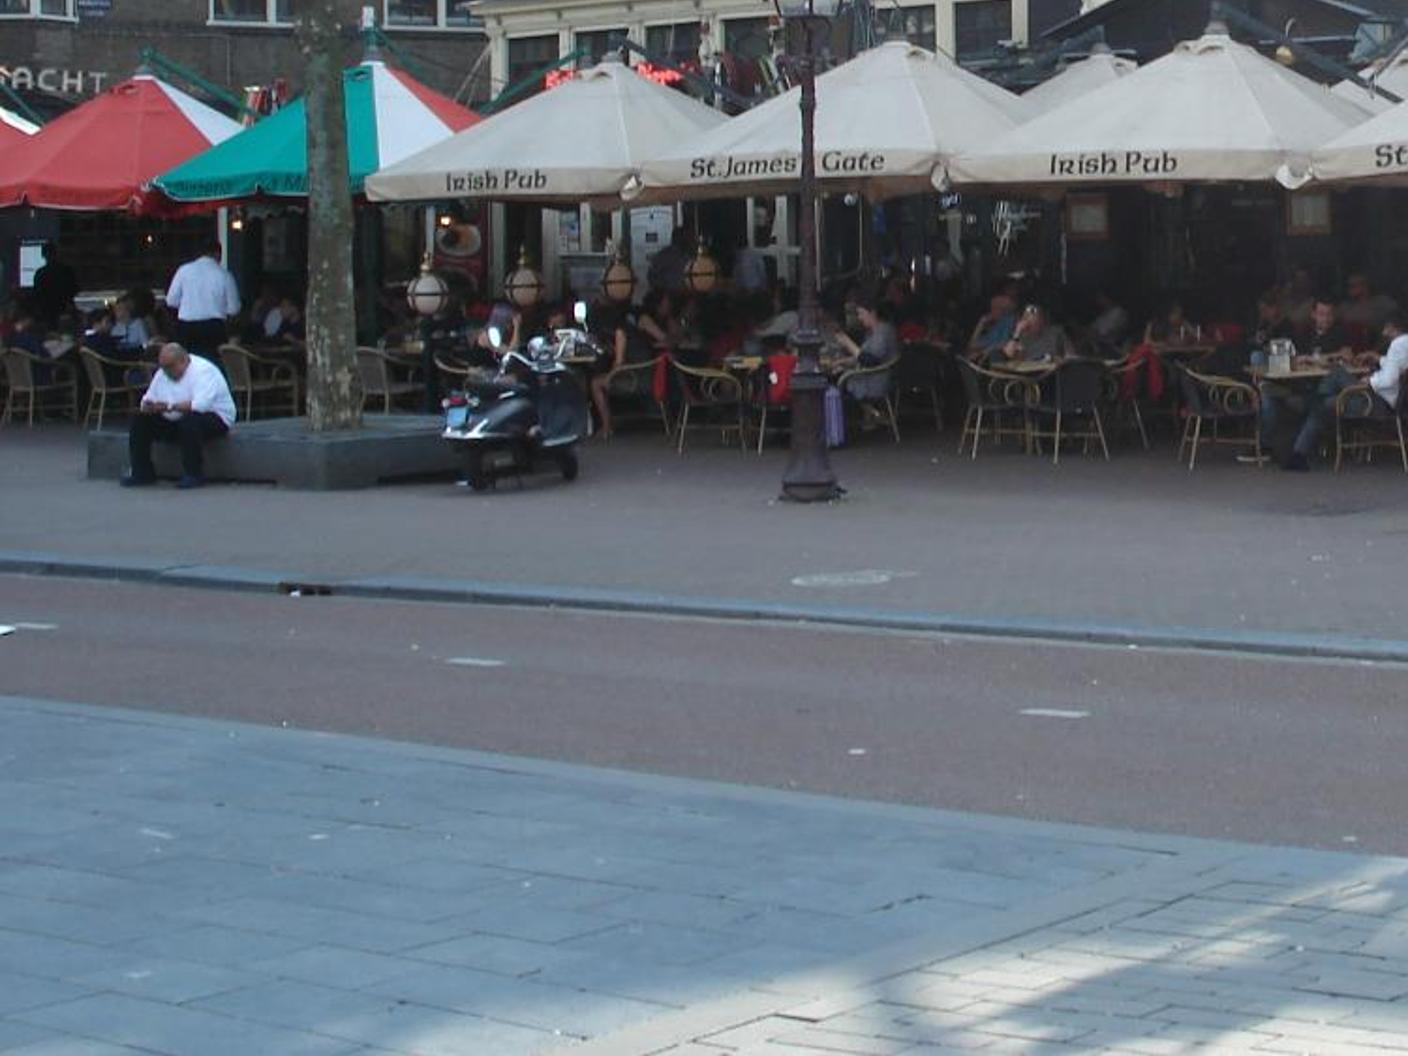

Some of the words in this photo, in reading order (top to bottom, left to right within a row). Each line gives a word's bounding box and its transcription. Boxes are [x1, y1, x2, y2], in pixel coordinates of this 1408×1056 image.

[11, 66, 107, 94] ACHT
[821, 150, 885, 172] Gate
[1050, 151, 1117, 175] Irish
[1125, 150, 1178, 173] Pub
[446, 169, 499, 192] Irish
[504, 169, 547, 189] Pub
